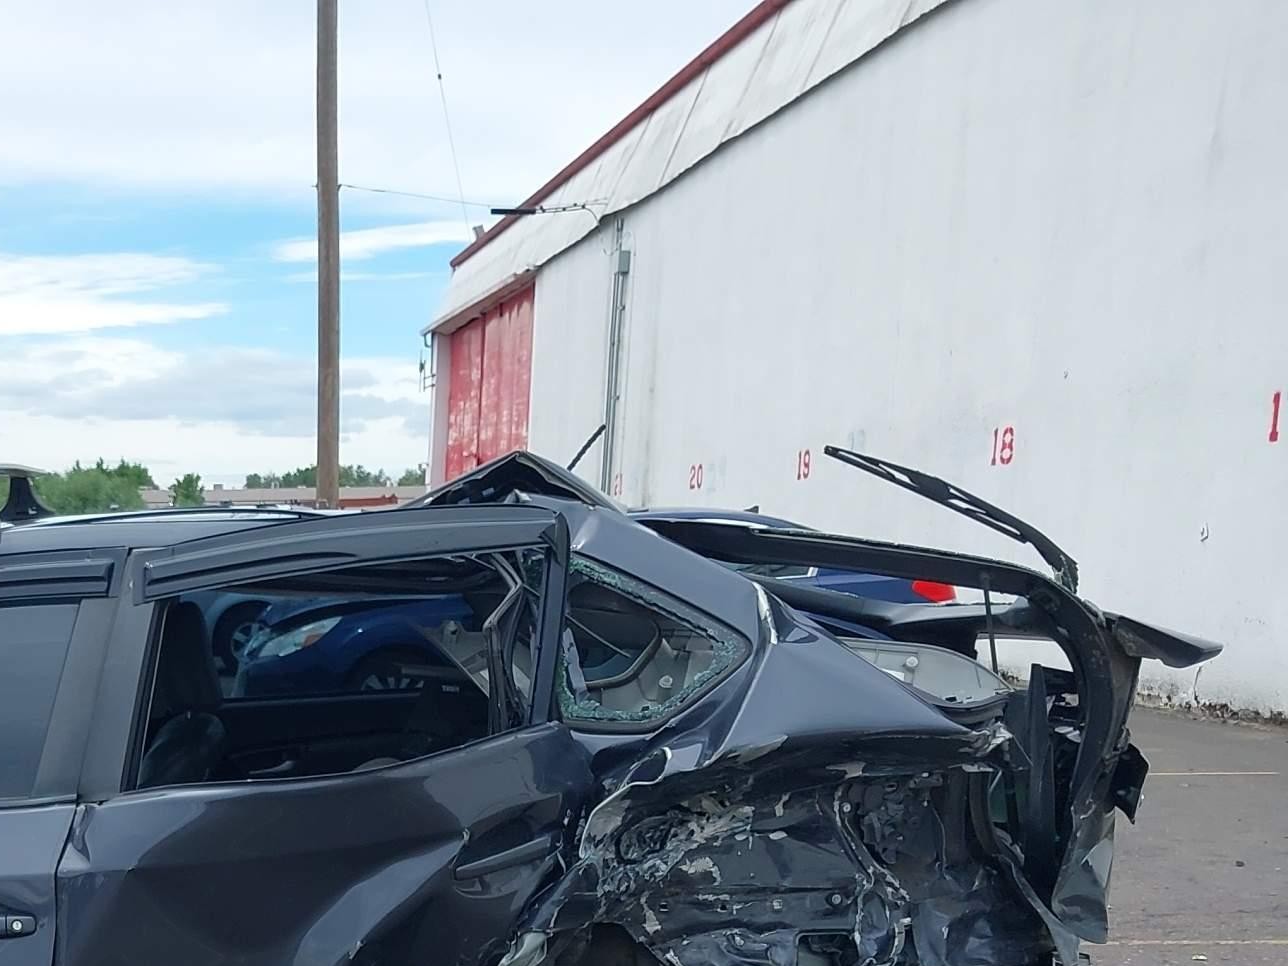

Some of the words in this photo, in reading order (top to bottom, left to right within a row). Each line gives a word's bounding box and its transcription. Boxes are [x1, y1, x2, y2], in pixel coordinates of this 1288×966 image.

[990, 426, 1015, 467] 18
[689, 463, 704, 491] 20
[796, 448, 811, 481] 19
